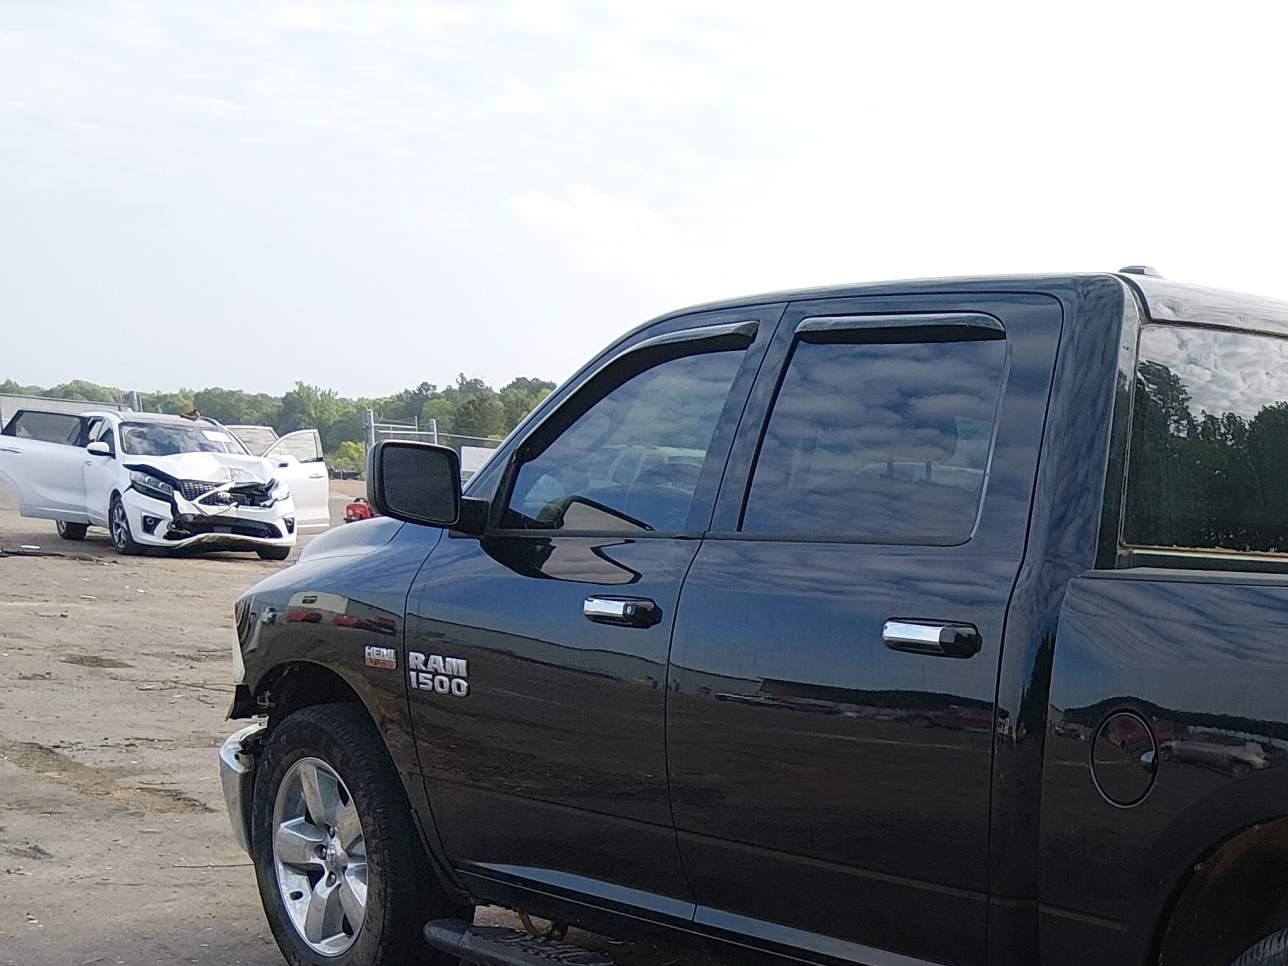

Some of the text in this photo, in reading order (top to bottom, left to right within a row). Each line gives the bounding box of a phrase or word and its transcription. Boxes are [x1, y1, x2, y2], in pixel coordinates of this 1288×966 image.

[364, 645, 396, 660] HEMI
[408, 651, 468, 677] RAM
[409, 671, 469, 697] 1500
